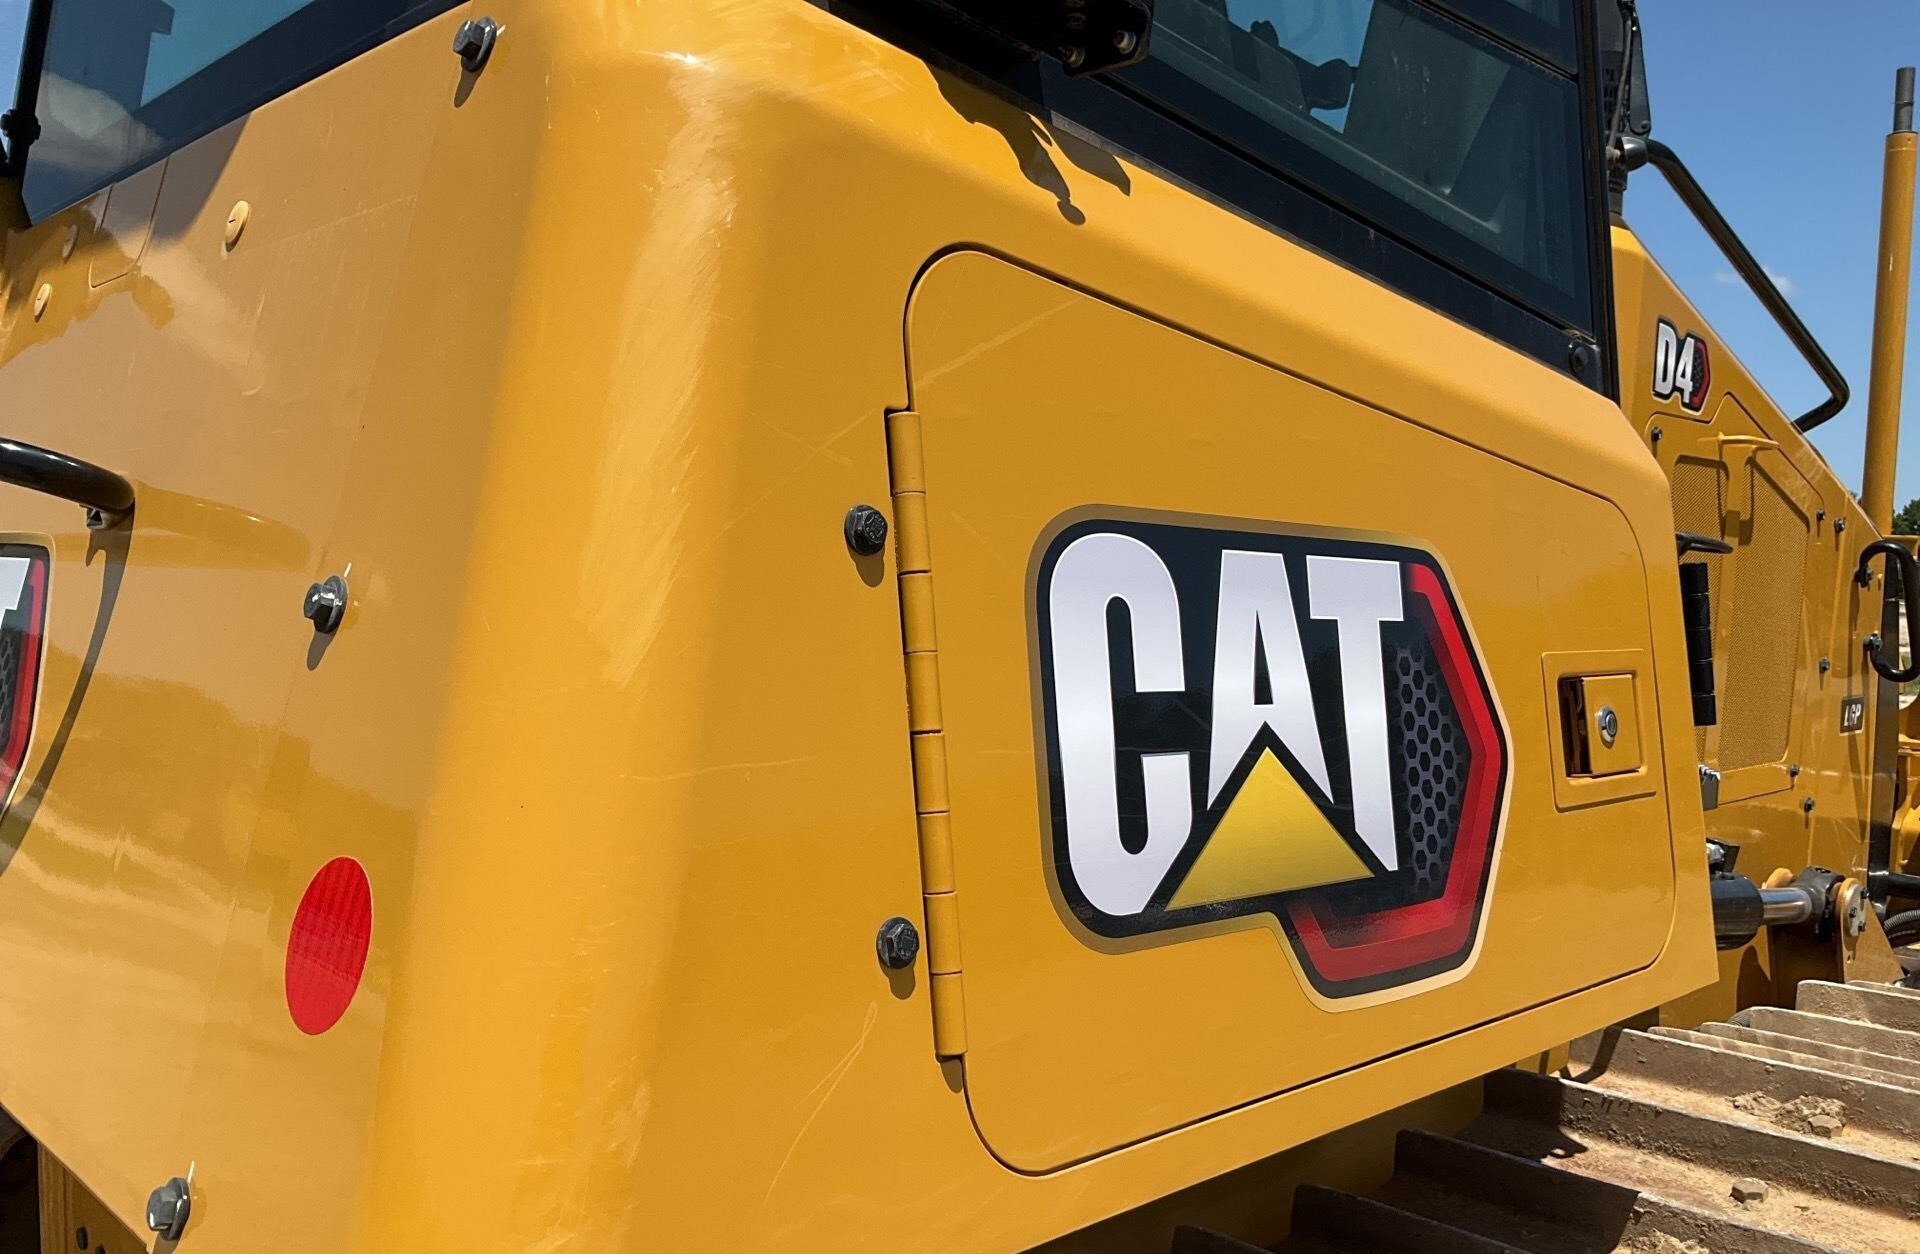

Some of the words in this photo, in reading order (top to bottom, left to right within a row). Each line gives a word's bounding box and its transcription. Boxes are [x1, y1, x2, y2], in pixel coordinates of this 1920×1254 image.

[1654, 322, 1695, 403] D4
[1049, 532, 1404, 917] CAT
[1843, 703, 1862, 726] LGP
